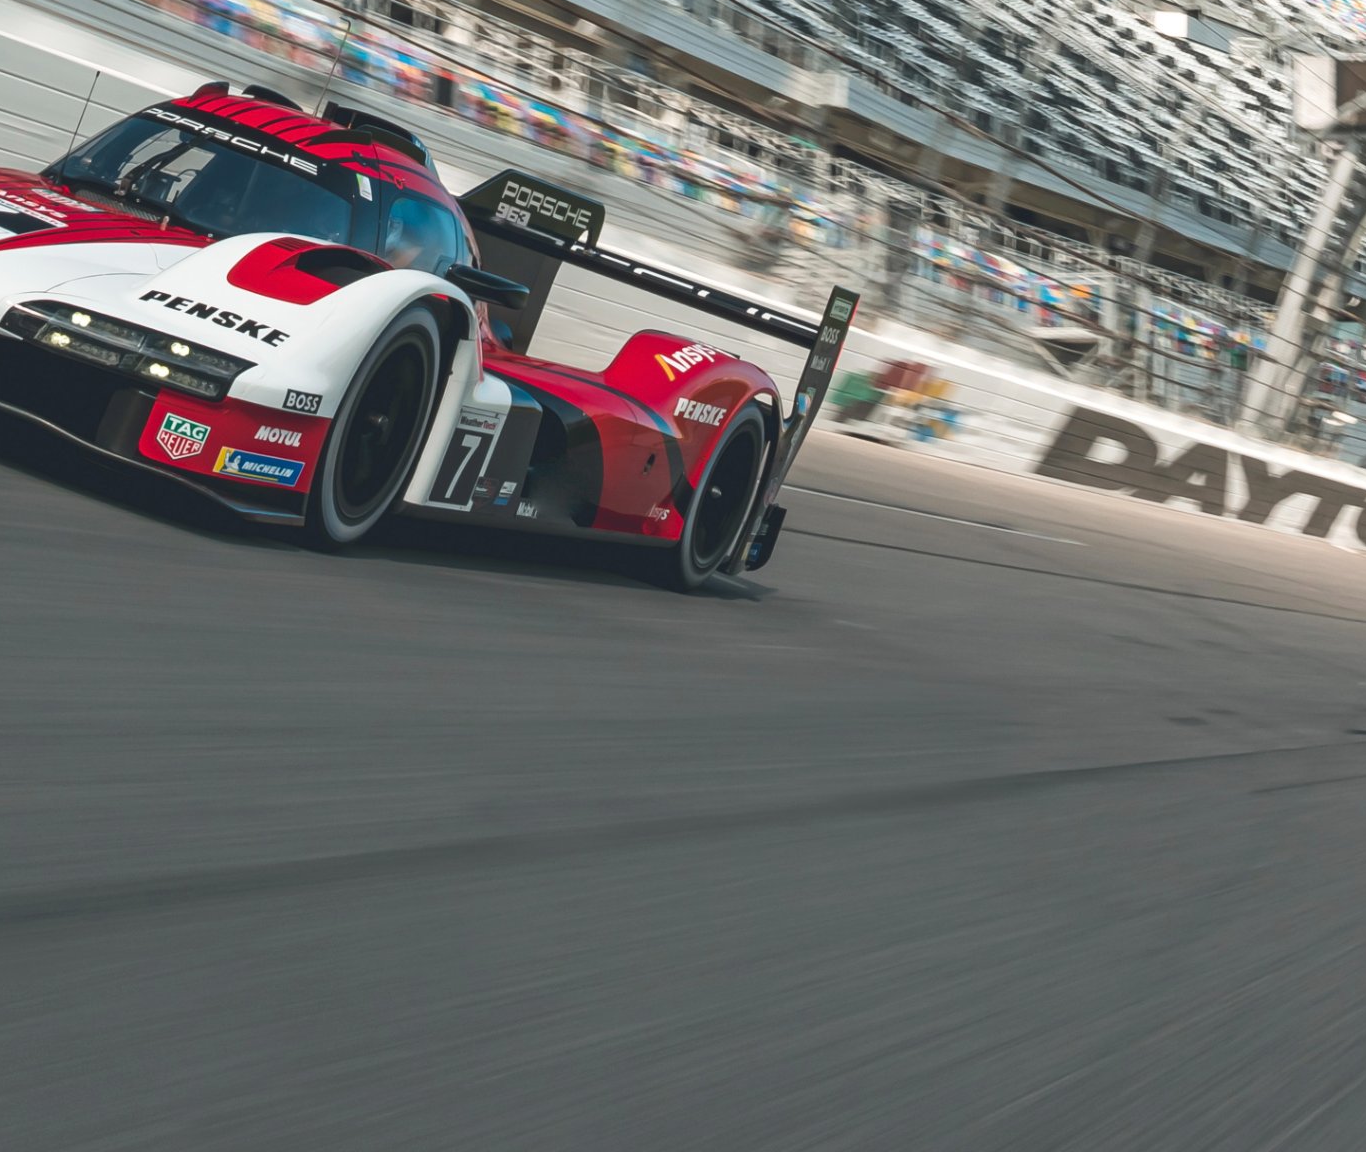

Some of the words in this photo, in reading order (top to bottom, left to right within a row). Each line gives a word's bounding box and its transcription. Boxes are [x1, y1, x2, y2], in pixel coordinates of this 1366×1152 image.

[142, 107, 318, 176] PORSCHE
[495, 201, 532, 227] 963
[501, 180, 592, 229] PORSCHE
[138, 289, 291, 348] PENSKE
[820, 325, 841, 345] BOSS
[654, 343, 716, 382] Ansys
[286, 392, 319, 412] BOSS
[673, 397, 727, 427] PENSKE
[168, 417, 206, 441] TAG
[254, 425, 303, 448] MOTUL
[160, 431, 202, 456] HEUER
[241, 461, 295, 478] MICHELIN
[444, 433, 483, 499] 7
